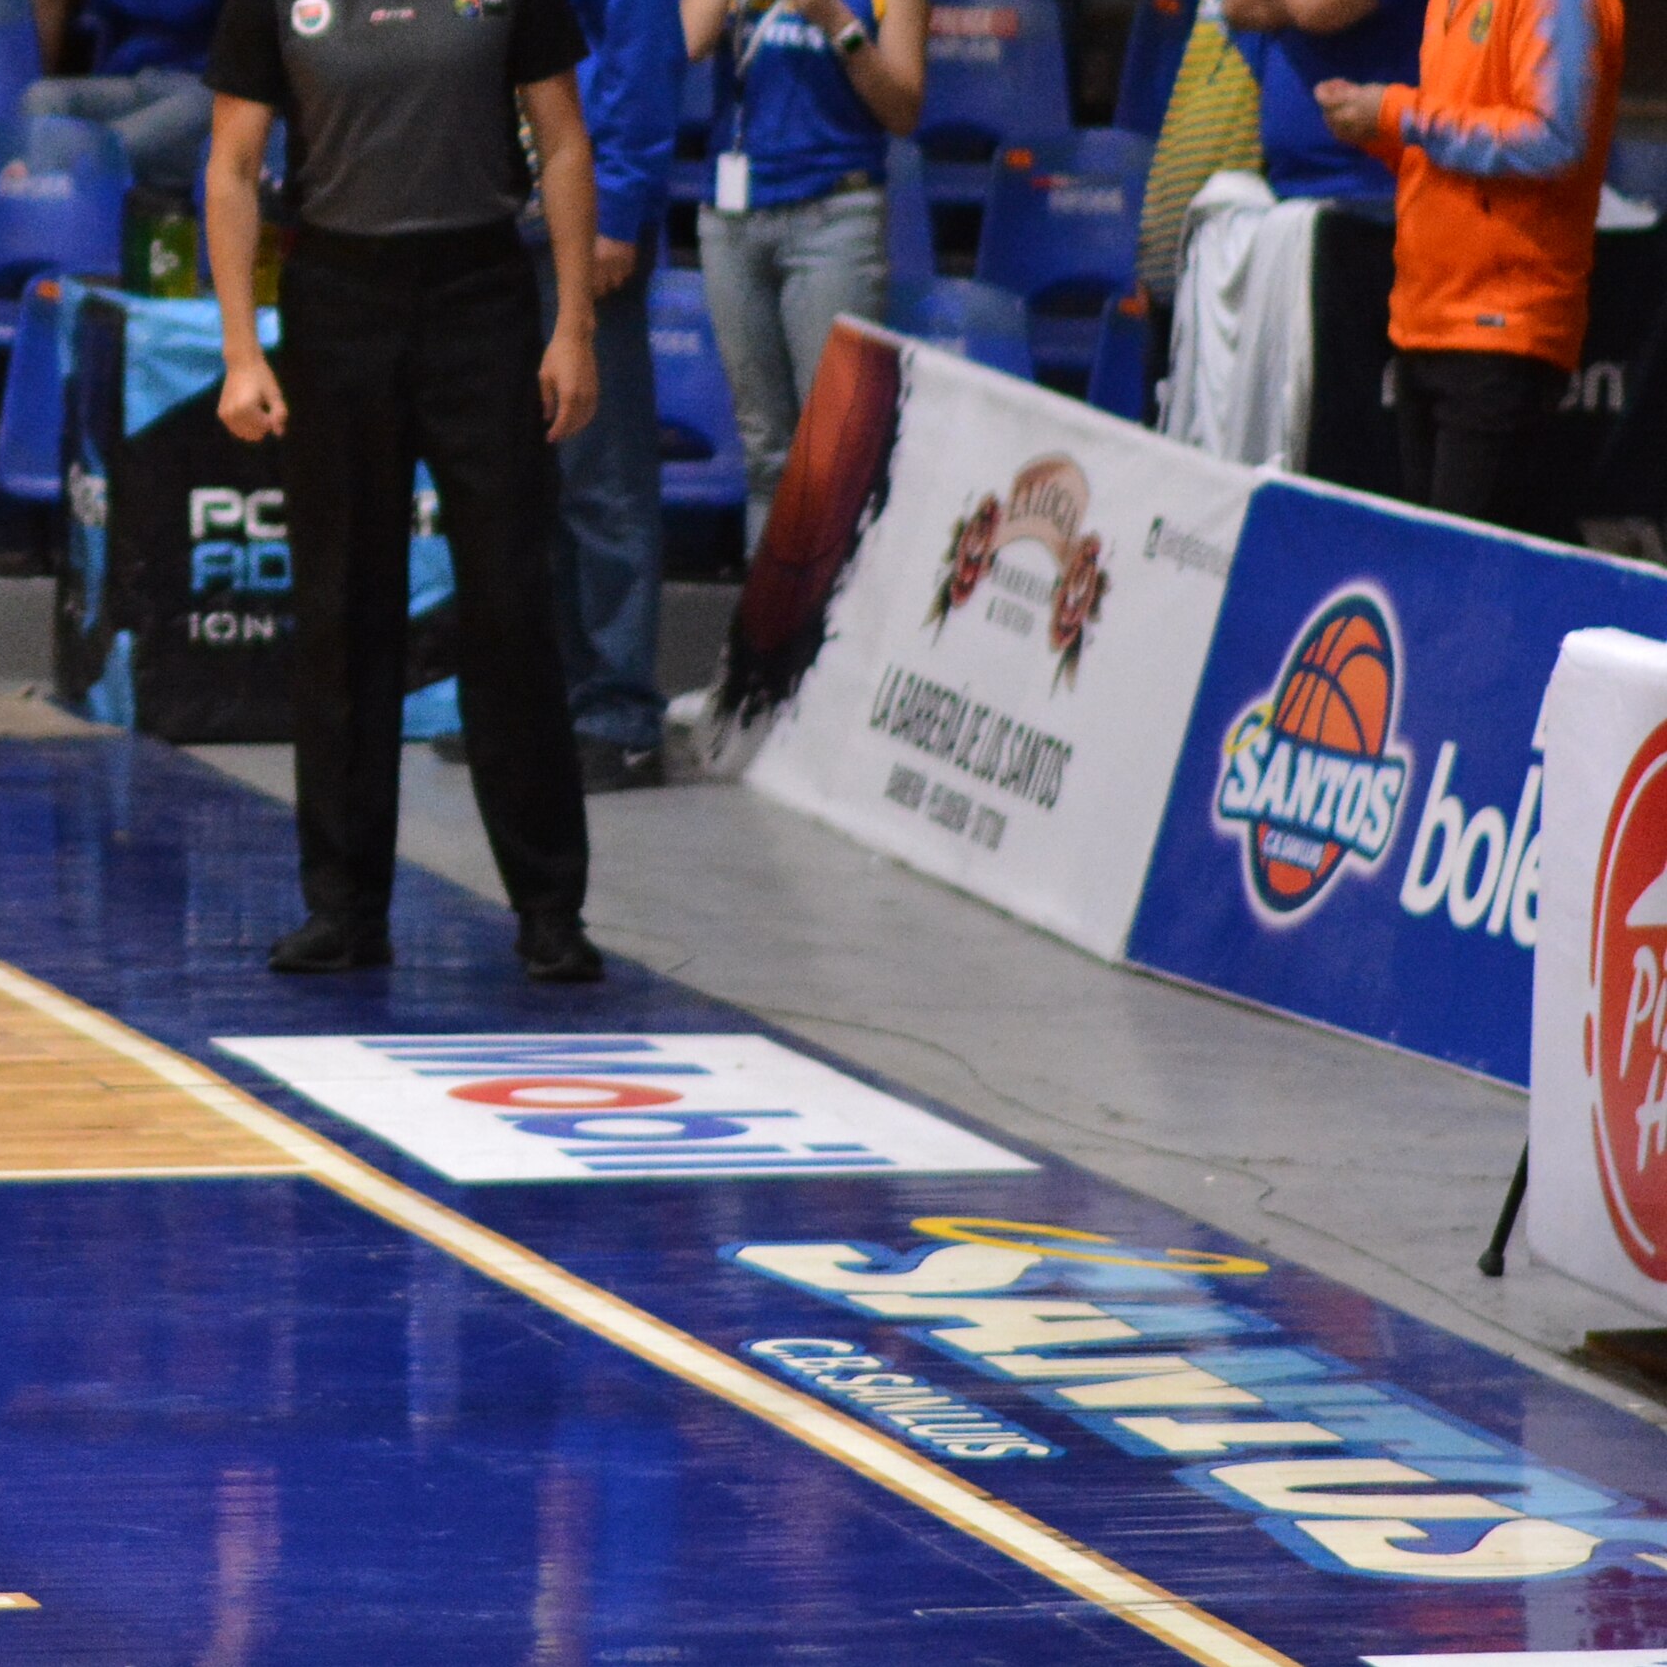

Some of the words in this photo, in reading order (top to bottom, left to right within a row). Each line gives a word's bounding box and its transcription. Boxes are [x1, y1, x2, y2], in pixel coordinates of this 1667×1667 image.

[1221, 717, 1403, 858] SANTOS
[355, 1039, 899, 1171] Mobil
[734, 1240, 1609, 1579] SANTOS
